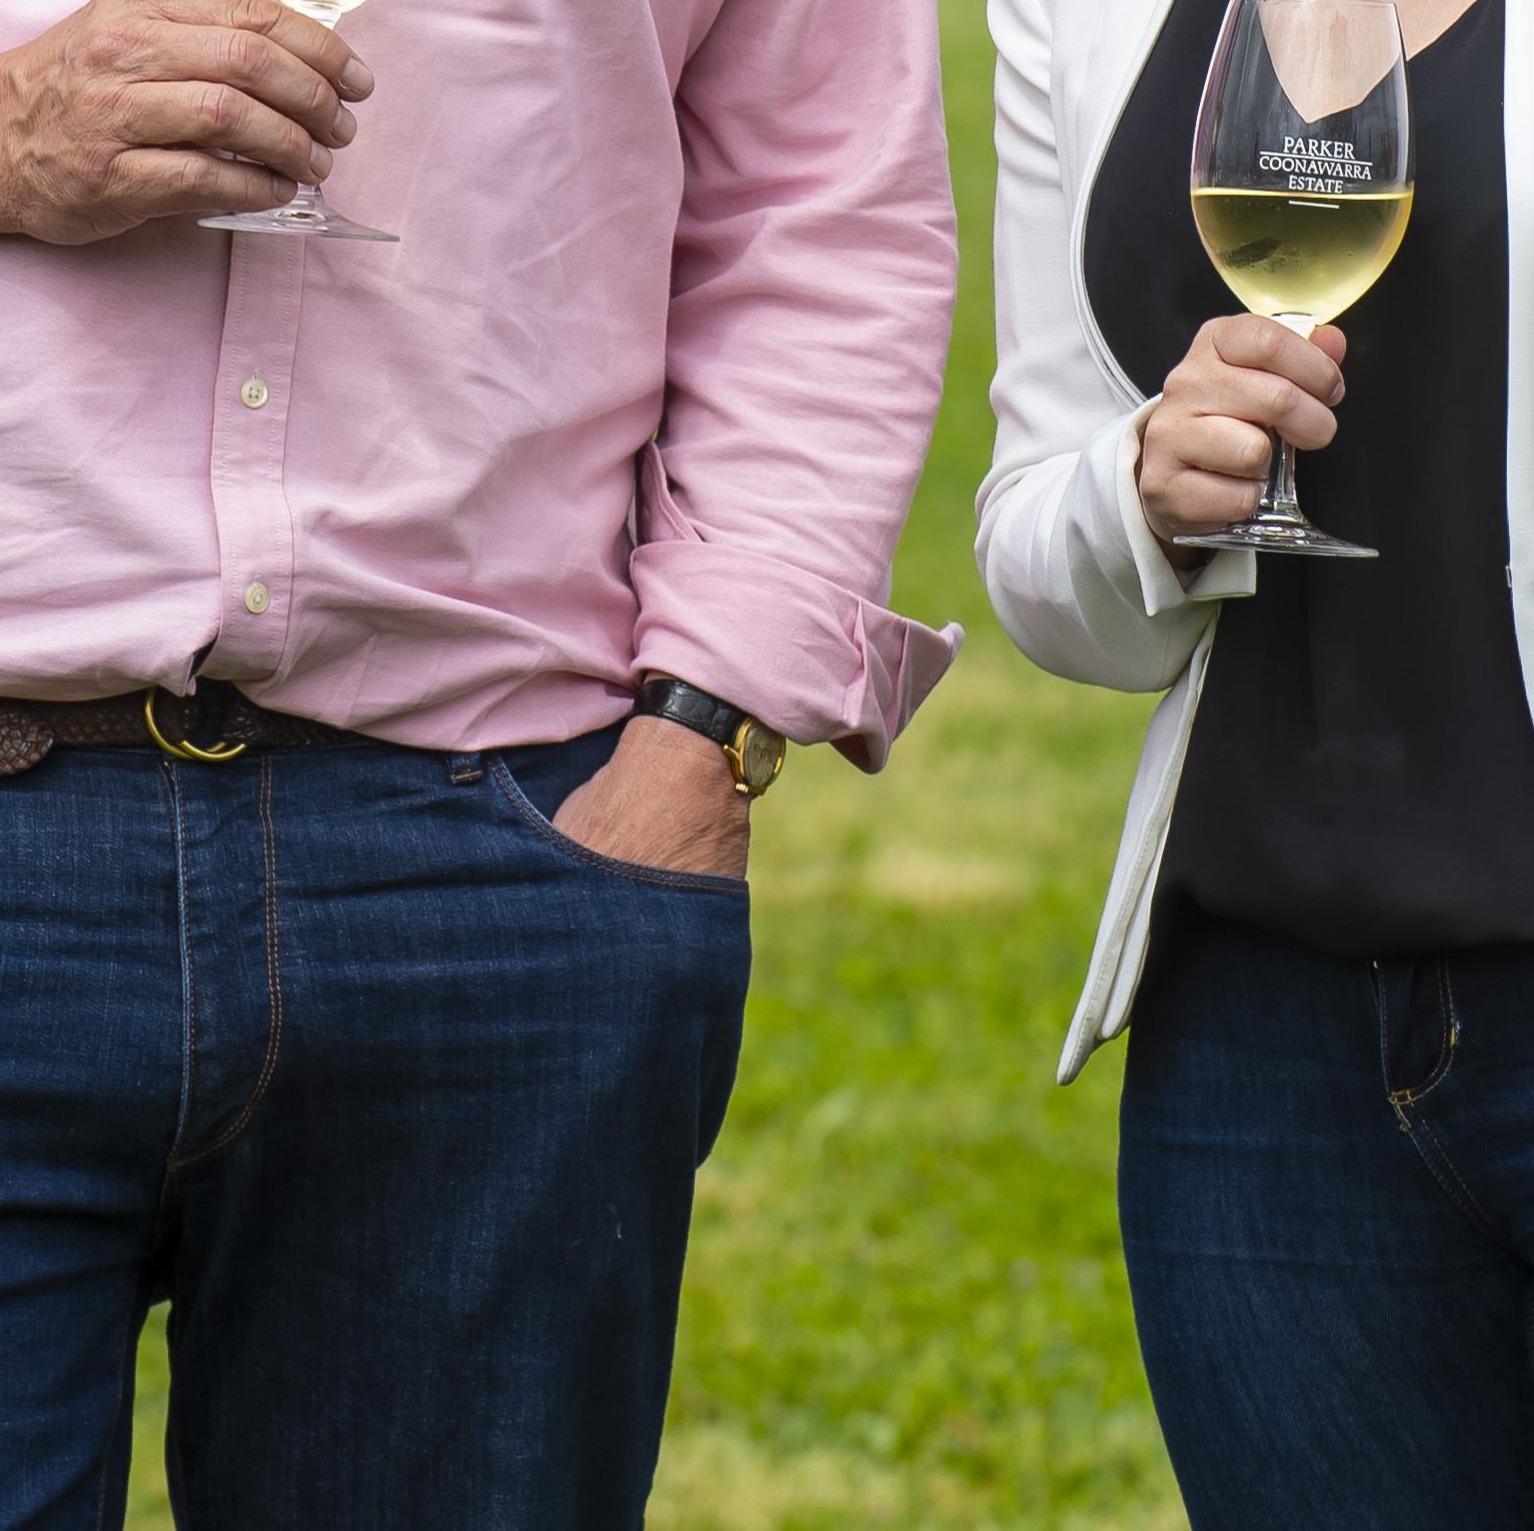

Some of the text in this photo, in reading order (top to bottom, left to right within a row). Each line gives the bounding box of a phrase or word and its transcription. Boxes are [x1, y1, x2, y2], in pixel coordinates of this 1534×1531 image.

[1283, 135, 1355, 160] PARKER
[1259, 156, 1372, 180] COONAWARRA
[1288, 175, 1343, 194] ESTATE
